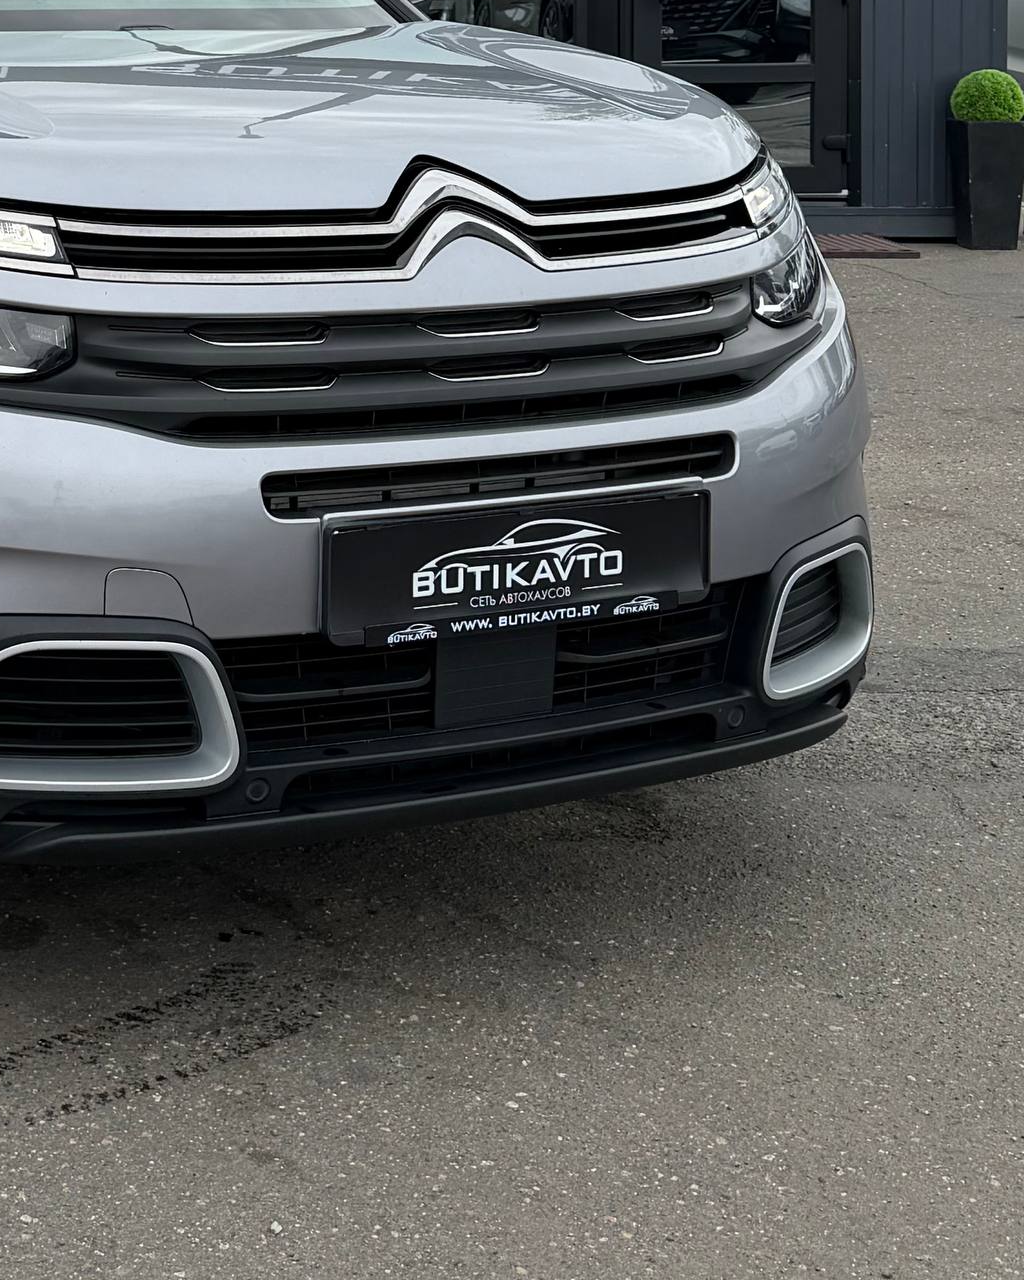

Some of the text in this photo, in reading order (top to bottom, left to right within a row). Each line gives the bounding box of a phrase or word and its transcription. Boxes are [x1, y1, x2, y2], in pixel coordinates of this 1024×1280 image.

[412, 550, 623, 598] BUTIKAVTO
[469, 585, 572, 608] СЕТЬ АВТОХАУСОВ
[451, 603, 601, 633] WWW. BUTIKAVTO.BY
[613, 602, 660, 616] BUTIKAVTO
[387, 631, 438, 645] BUTIKAVTO
